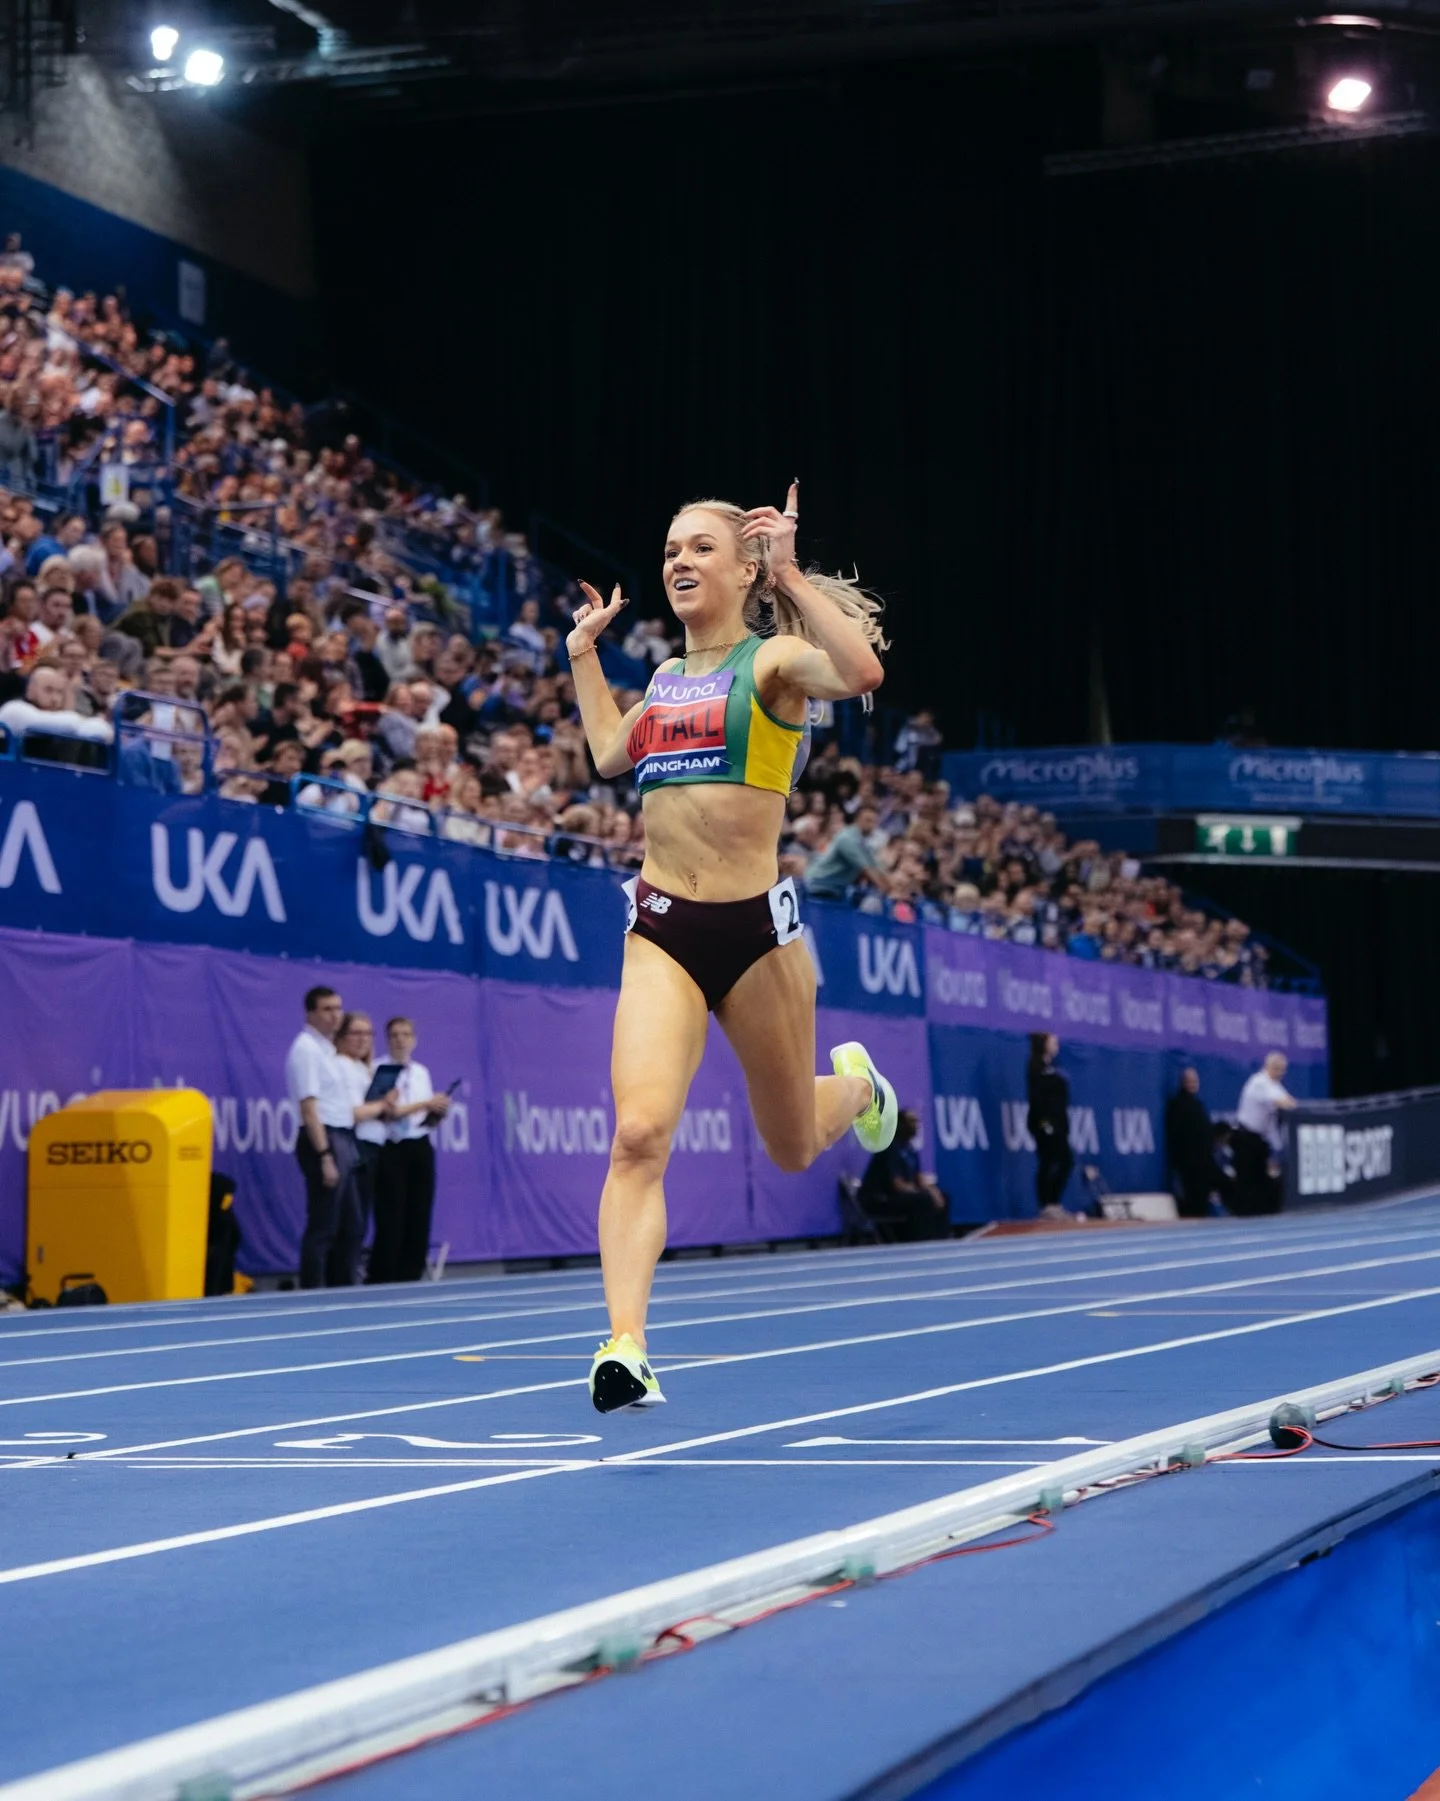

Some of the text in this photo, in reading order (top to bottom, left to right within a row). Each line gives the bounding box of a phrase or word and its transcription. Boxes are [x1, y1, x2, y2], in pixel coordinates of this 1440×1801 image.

[629, 709, 719, 756] NUTTALL
[151, 821, 287, 923] UKA
[356, 856, 465, 945] UKA
[483, 880, 580, 962] UKA
[779, 889, 799, 934] 2
[858, 932, 921, 998] UKA
[46, 1140, 152, 1166] SEIKO
